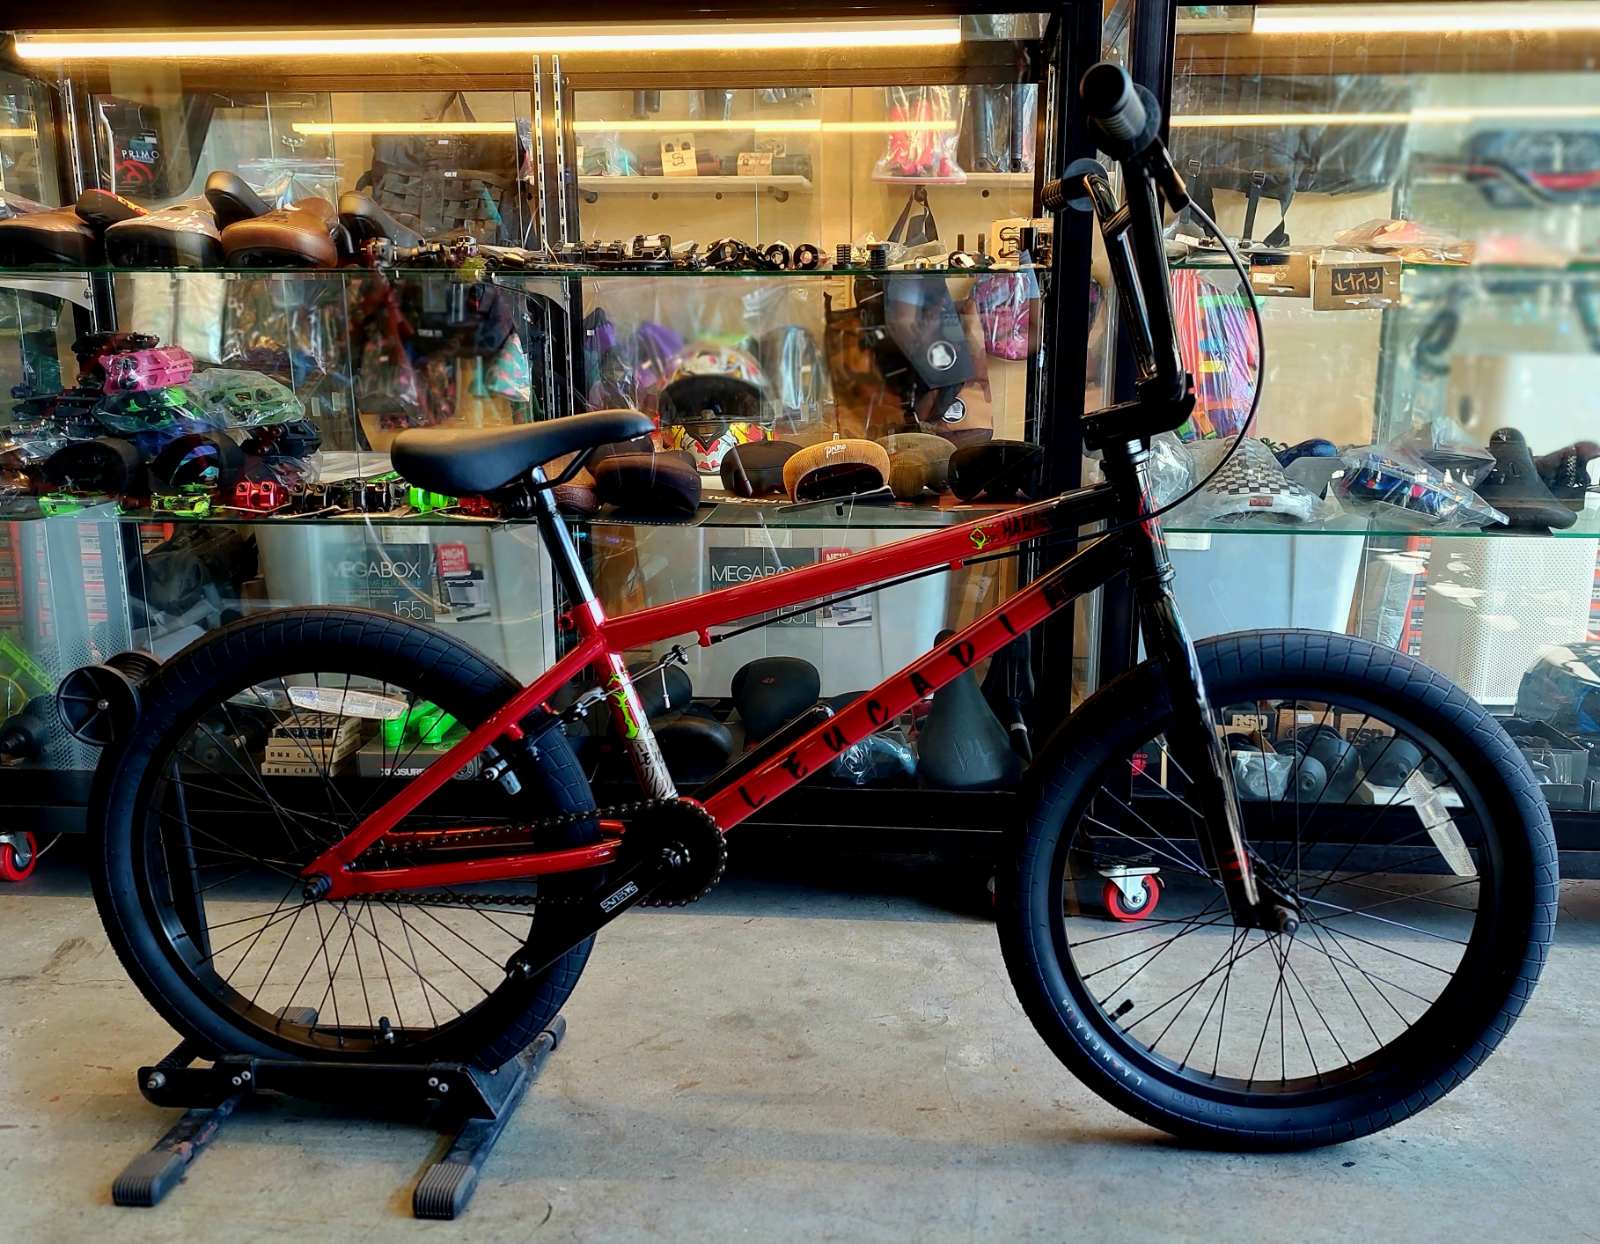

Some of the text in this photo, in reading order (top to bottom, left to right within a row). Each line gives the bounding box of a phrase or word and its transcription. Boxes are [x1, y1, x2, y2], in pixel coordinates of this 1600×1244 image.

[121, 149, 160, 160] PRIMO
[1334, 271, 1381, 292] CULT
[392, 601, 432, 620] 155L
[1232, 714, 1268, 730] BSD
[296, 751, 328, 759] CHIN
[1075, 1021, 1113, 1062] MESA
